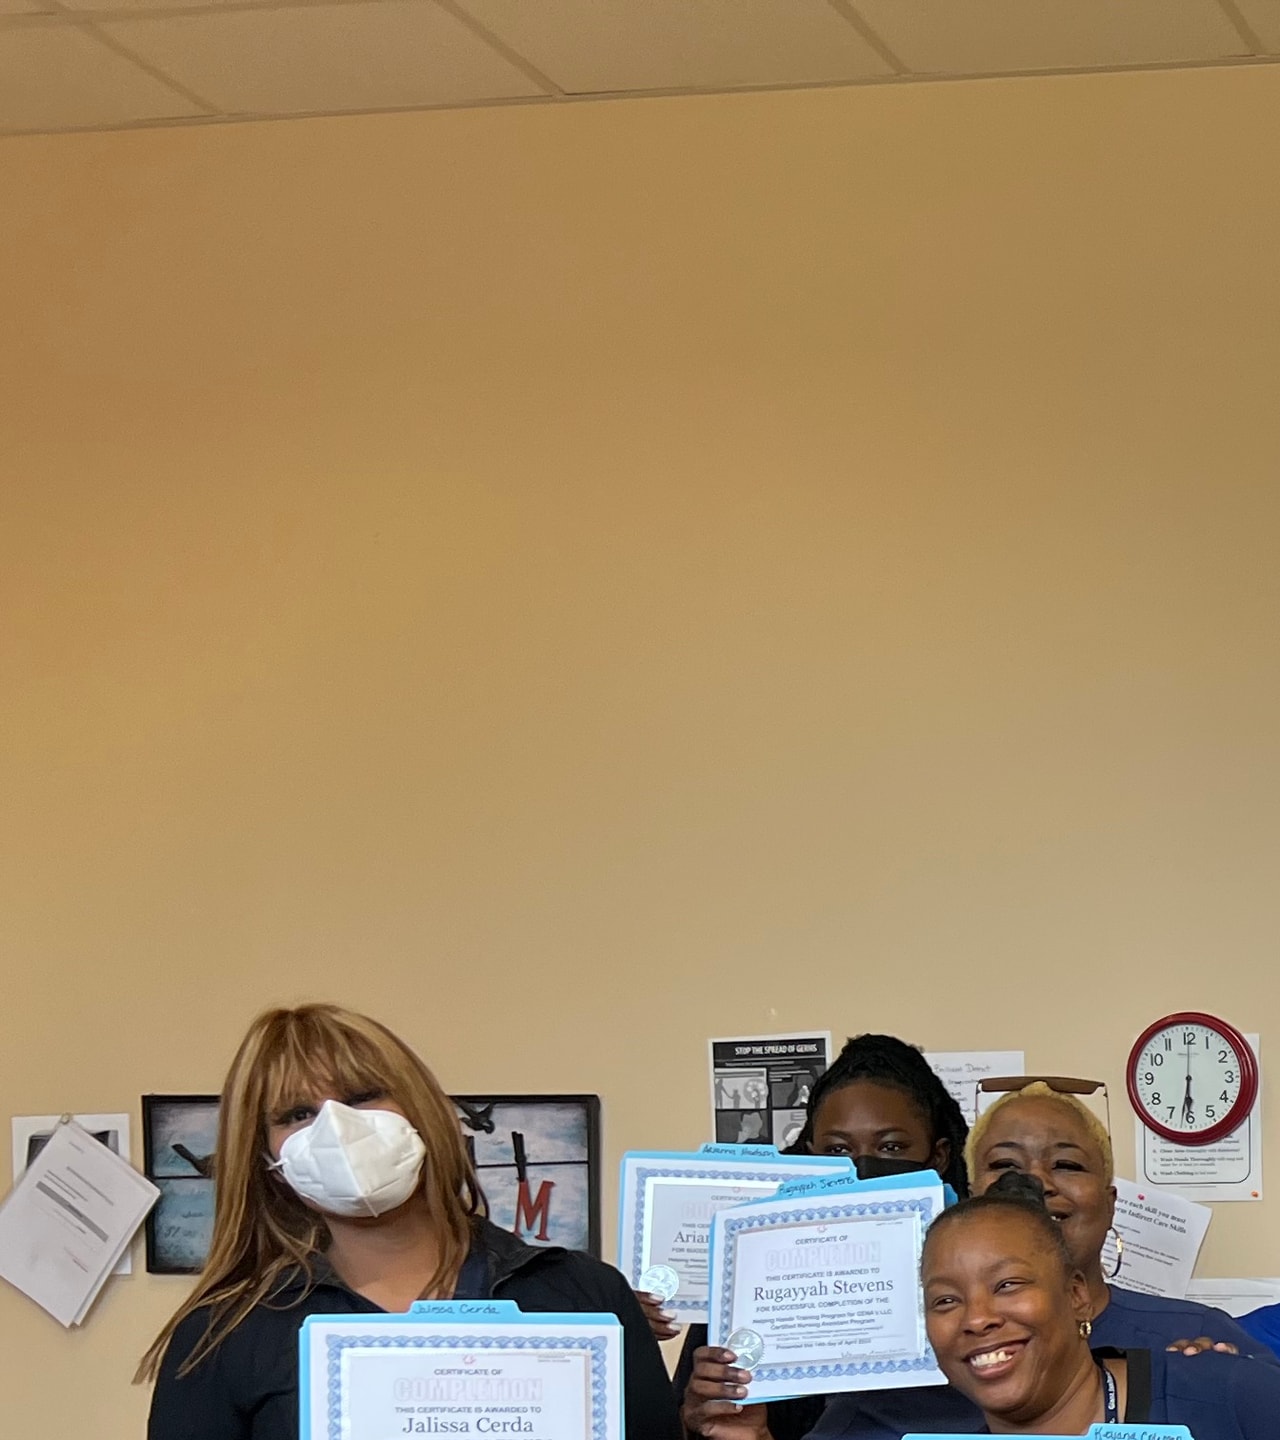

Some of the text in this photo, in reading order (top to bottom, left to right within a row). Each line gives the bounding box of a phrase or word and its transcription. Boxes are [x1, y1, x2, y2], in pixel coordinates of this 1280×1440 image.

[1165, 1038, 1171, 1051] 11
[1184, 1032, 1196, 1045] 12
[1206, 1036, 1209, 1049] 1
[735, 1047, 751, 1055] STOP
[764, 1045, 787, 1053] SPREAD
[796, 1044, 817, 1052] GERMS
[1150, 1053, 1163, 1066] 10
[1218, 1051, 1228, 1063] 2
[1145, 1073, 1154, 1085] 9
[1225, 1071, 1234, 1083] 3
[1152, 1092, 1161, 1105] 8
[1220, 1090, 1228, 1103] 4
[1167, 1107, 1175, 1119] 7
[1186, 1111, 1195, 1123] 6
[1206, 1105, 1215, 1117] 5
[512, 1178, 556, 1241] M
[1145, 1206, 1157, 1214] skill
[1159, 1210, 1169, 1218] you
[1171, 1215, 1186, 1223] must
[1154, 1219, 1167, 1228] Care
[1170, 1224, 1186, 1233] Skills
[754, 1279, 893, 1301] Rugayyah Stevens
[394, 1378, 542, 1401] COMPLETION
[402, 1417, 533, 1433] Jalissa Cerda
